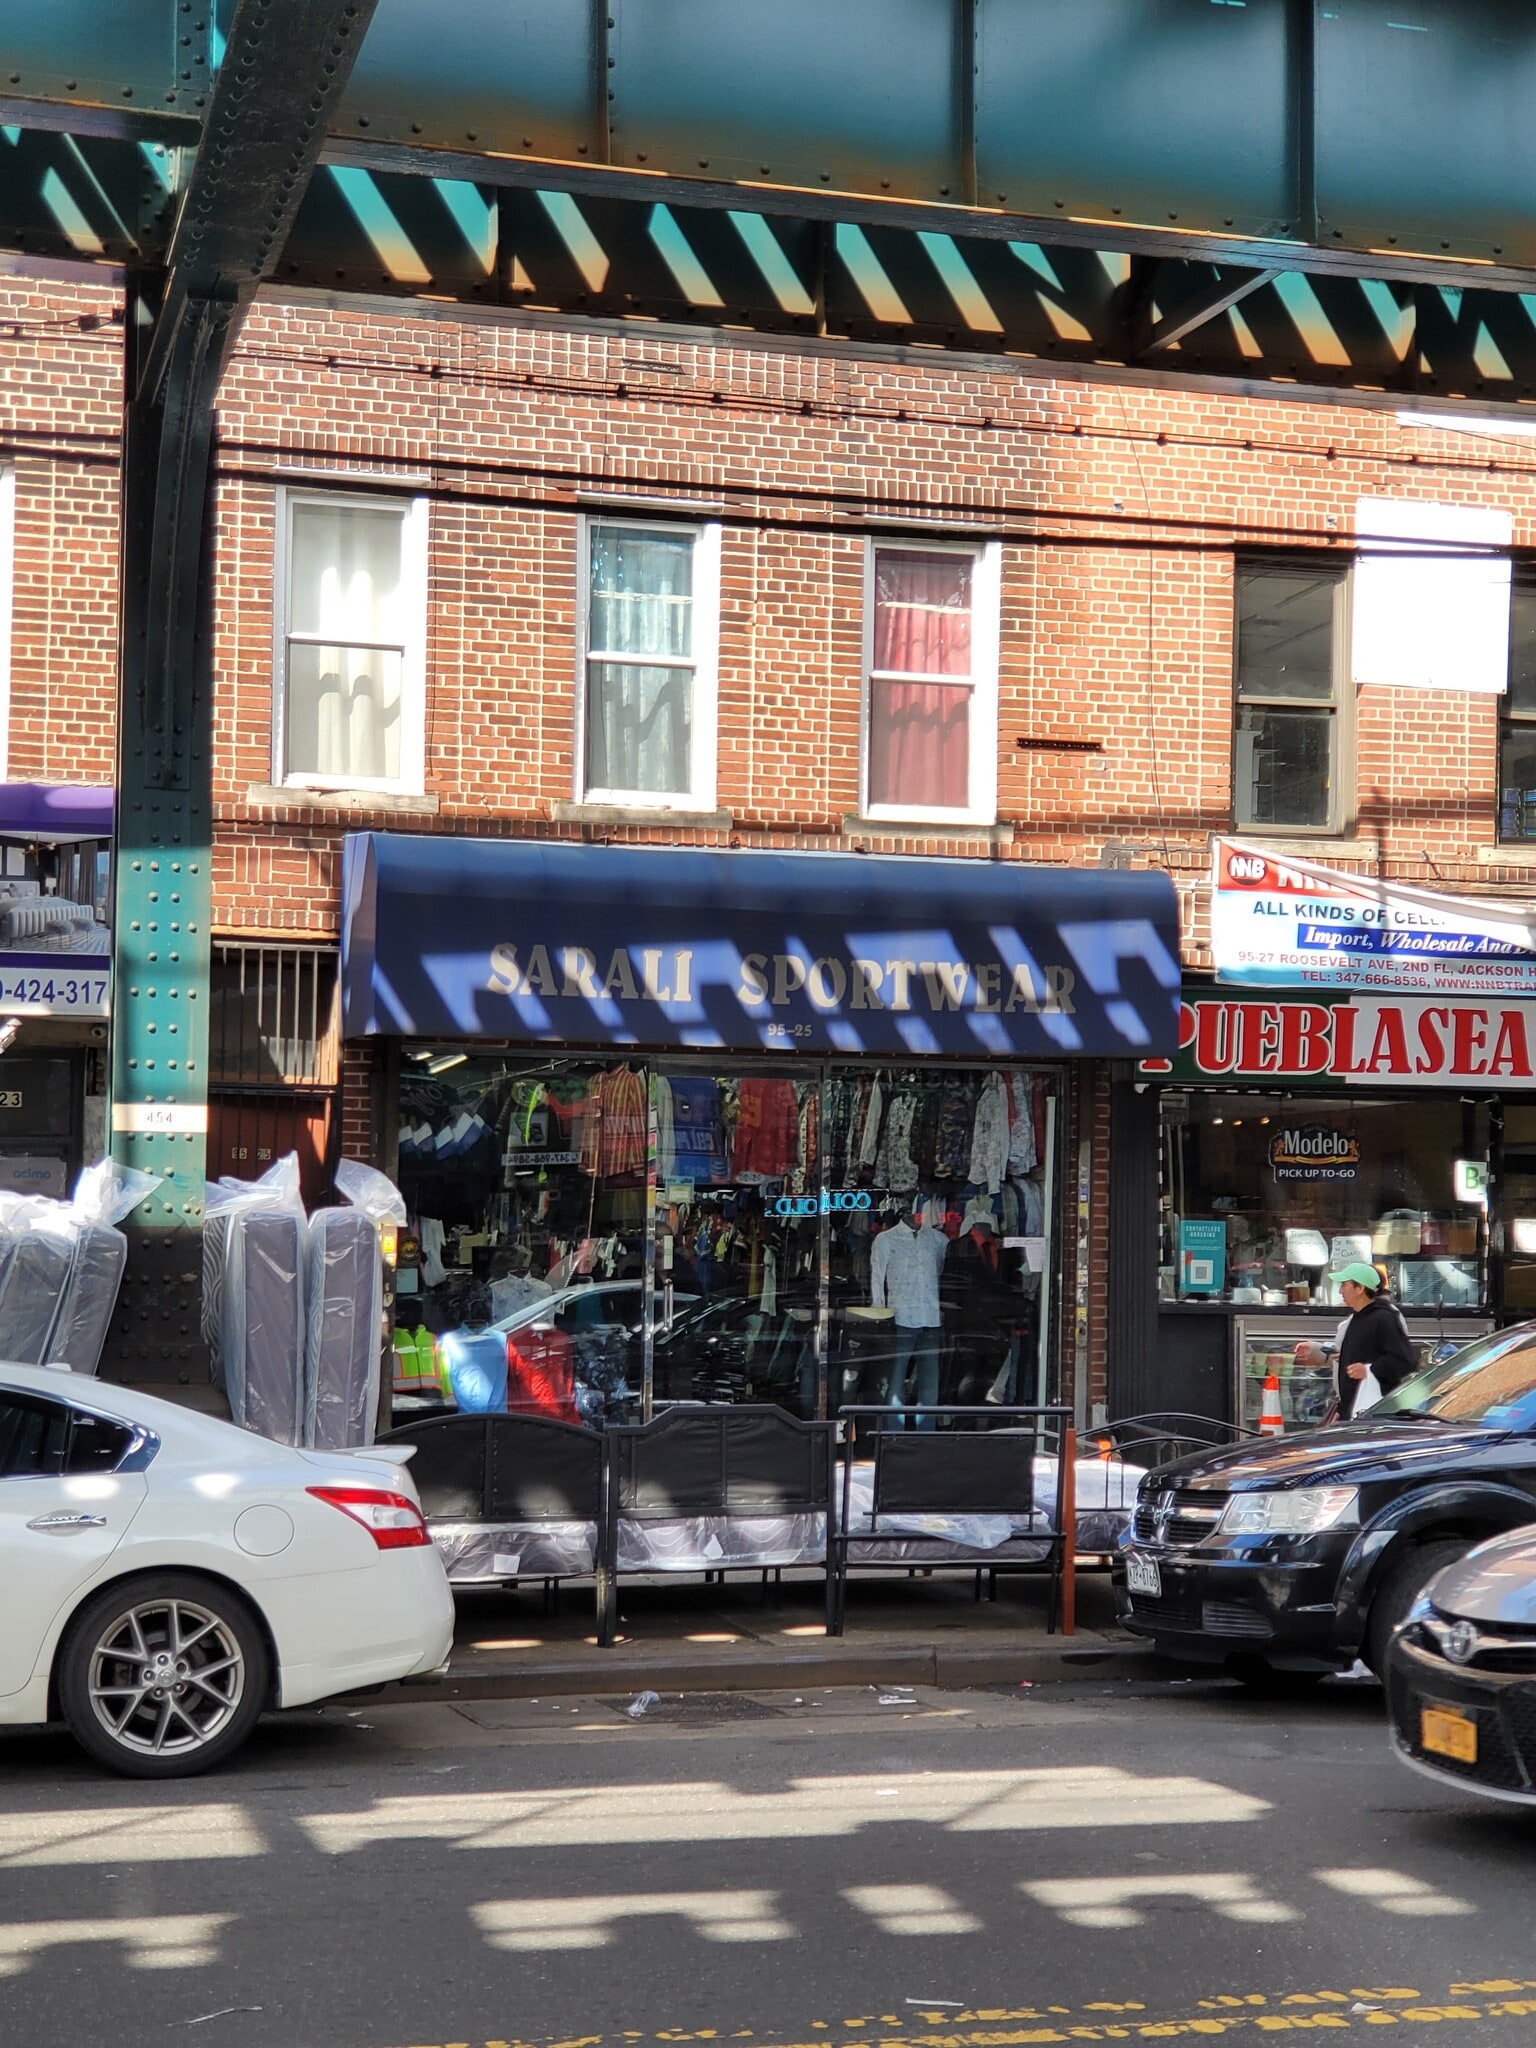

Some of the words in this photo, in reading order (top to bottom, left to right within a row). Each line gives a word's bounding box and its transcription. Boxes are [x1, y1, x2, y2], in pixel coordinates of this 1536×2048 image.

[1253, 901, 1288, 916] ALL
[1295, 903, 1355, 921] KINDS
[1362, 908, 1387, 923] OF
[1304, 926, 1374, 950] Import,
[1380, 931, 1474, 953] Wholesale
[1238, 951, 1275, 963] 95-27
[1280, 953, 1363, 968] ROOSEVELT
[1368, 959, 1398, 972] AVE,
[1402, 961, 1429, 973] 2ND
[1434, 963, 1454, 976] FL,
[1458, 964, 1524, 977] JACKSON
[487, 942, 694, 1002] SARALI
[737, 953, 1077, 1014] SPORTWEAR
[1301, 970, 1331, 982] TEL:
[1335, 972, 1431, 989] 347-666-8536,
[0, 979, 107, 1004] -424-317
[766, 1023, 813, 1037] 95-25
[1284, 1130, 1349, 1155] Modelo
[1279, 1169, 1303, 1178] PICK
[1305, 1169, 1320, 1178] UP
[1322, 1169, 1356, 1178] TO-GO
[1465, 1166, 1480, 1189] B
